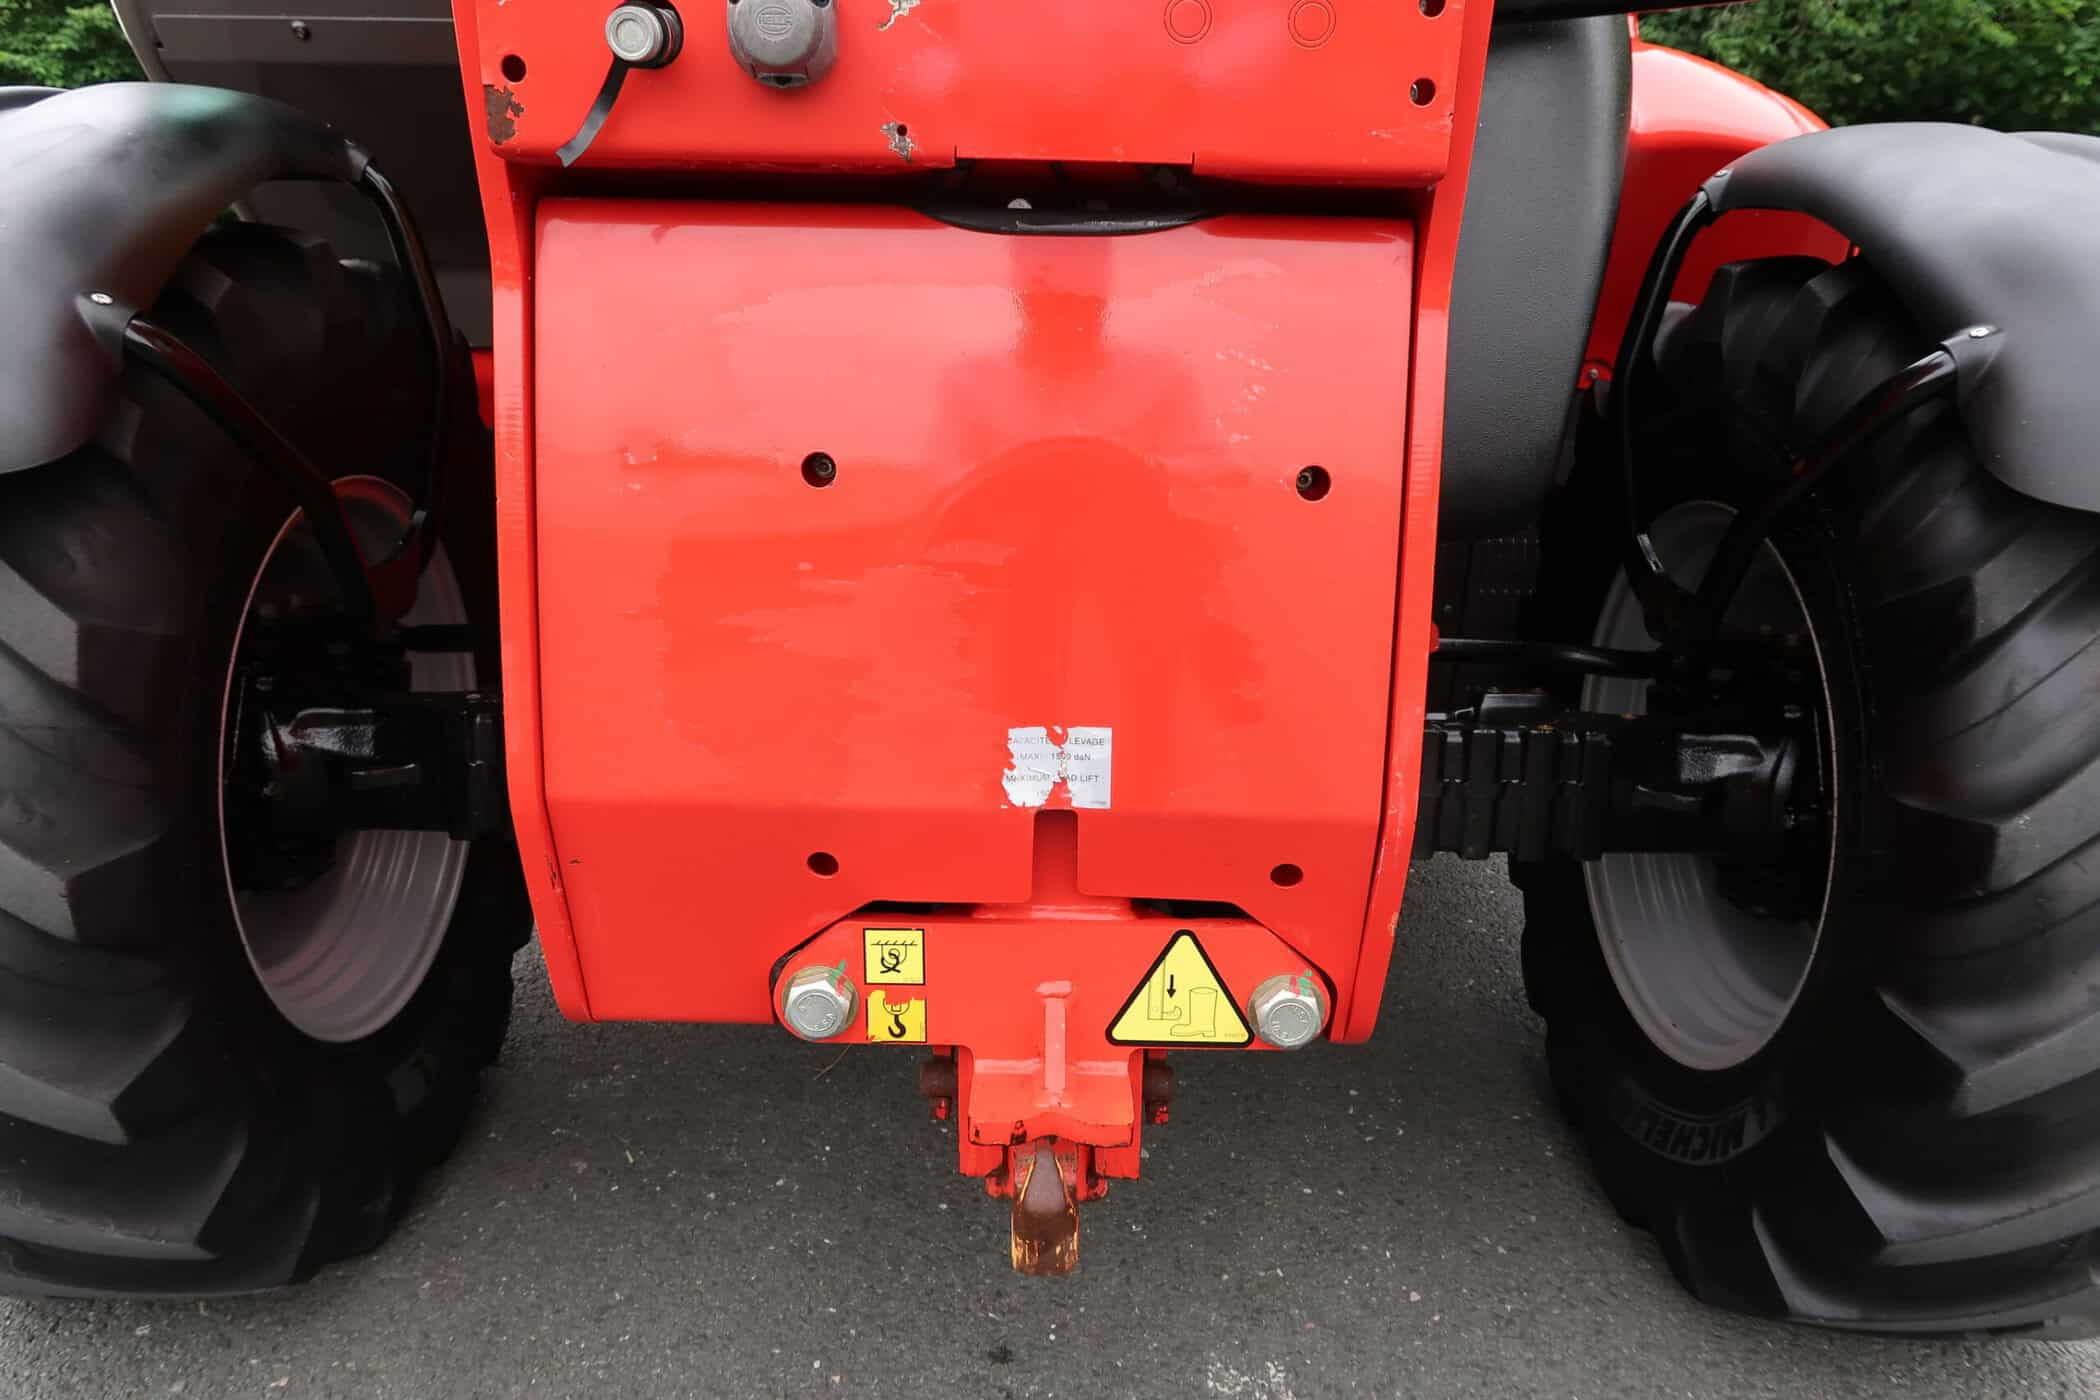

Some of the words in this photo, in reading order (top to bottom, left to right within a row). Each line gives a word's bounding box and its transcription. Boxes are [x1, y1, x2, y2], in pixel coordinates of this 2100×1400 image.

[1068, 736, 1105, 746] LEVAGE
[1073, 751, 1091, 761] daN
[1079, 774, 1100, 784] LIFT
